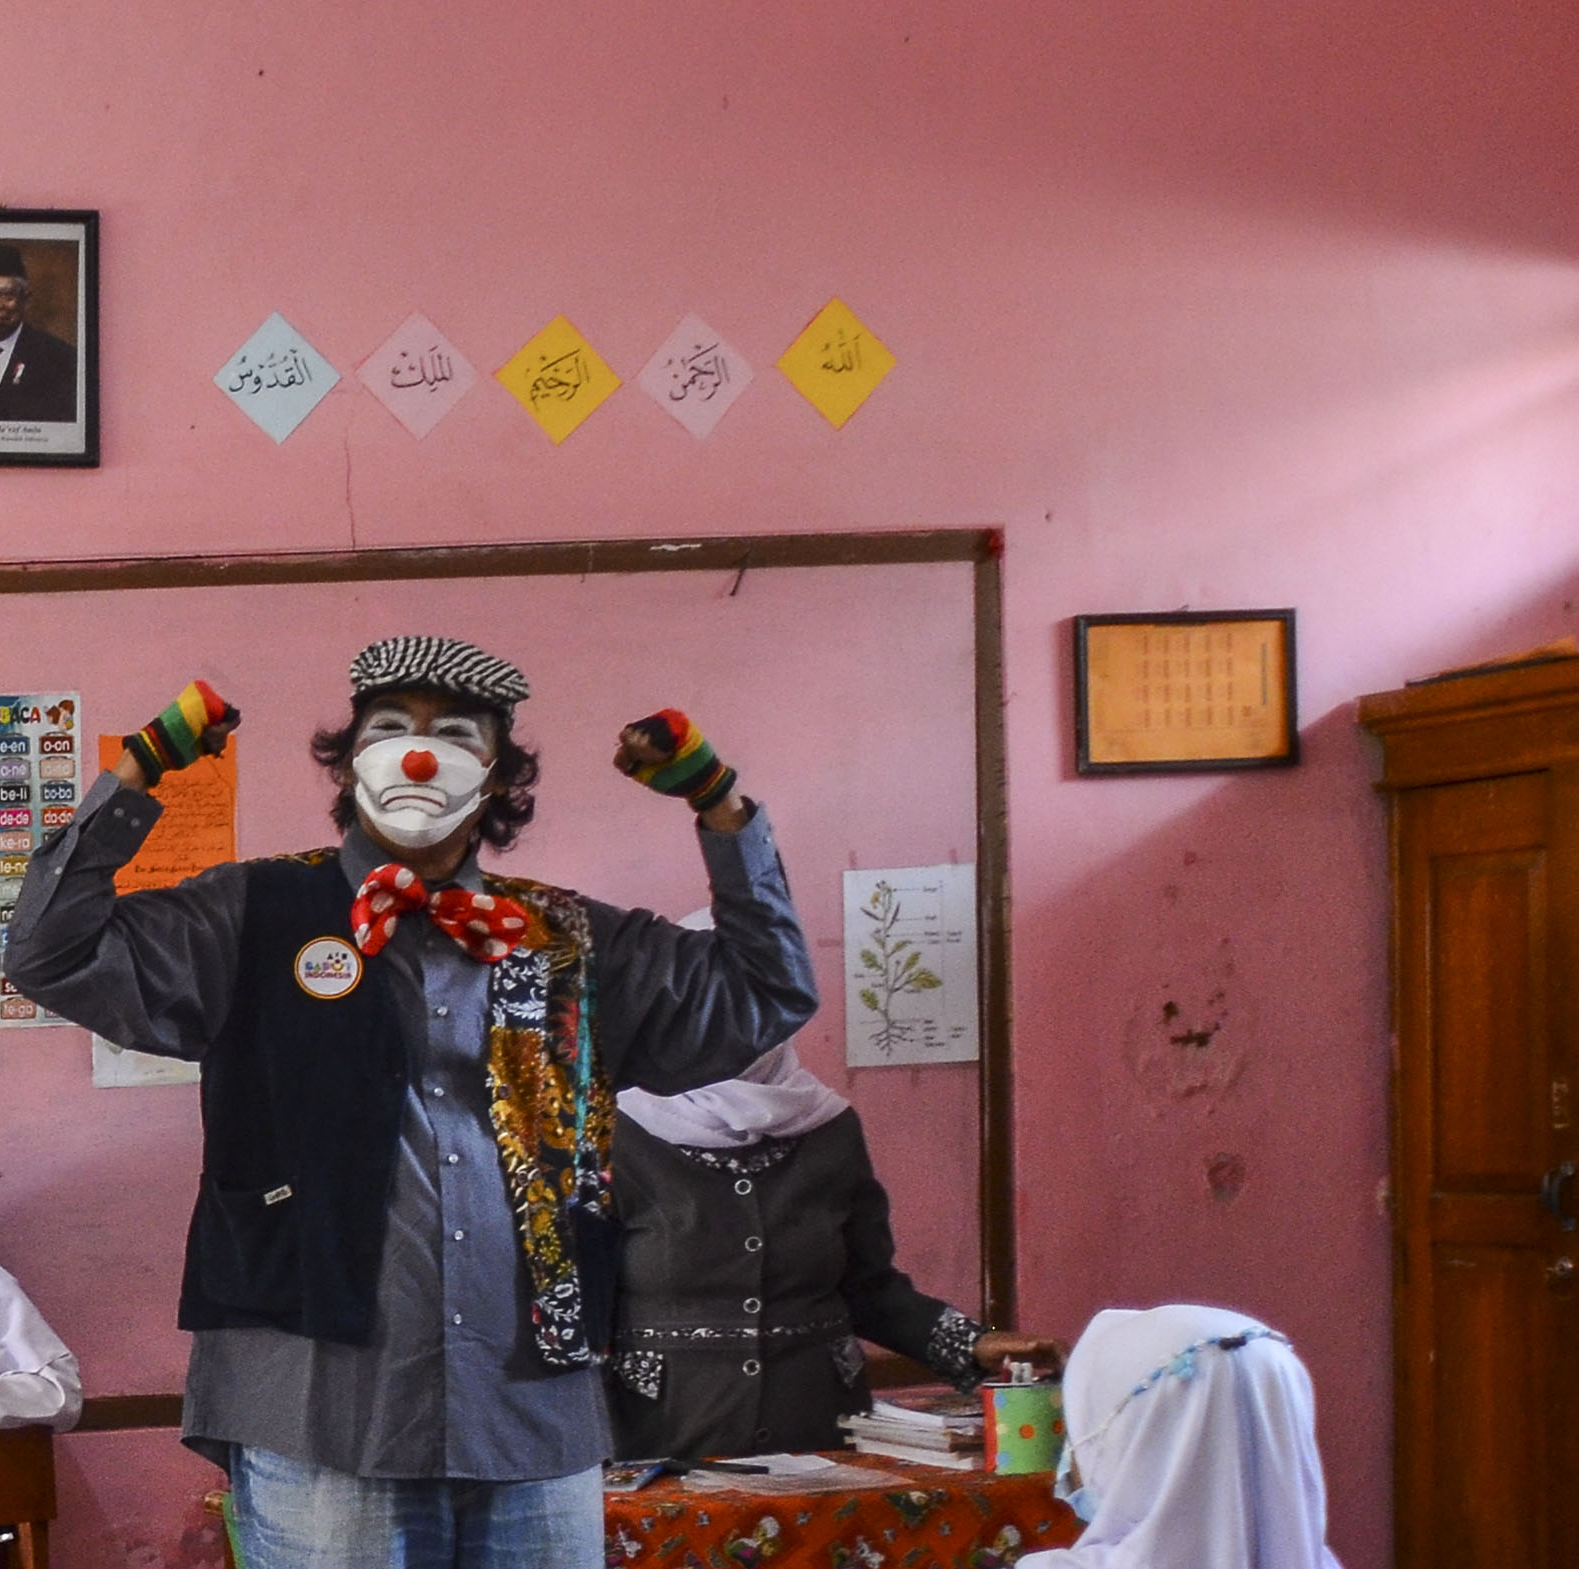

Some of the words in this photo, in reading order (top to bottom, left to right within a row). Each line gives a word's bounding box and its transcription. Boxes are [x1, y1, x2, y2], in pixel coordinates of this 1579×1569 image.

[0, 740, 26, 753] e-en
[0, 786, 27, 800] be-li
[0, 811, 29, 825] de-de
[0, 836, 30, 849] ke-ra
